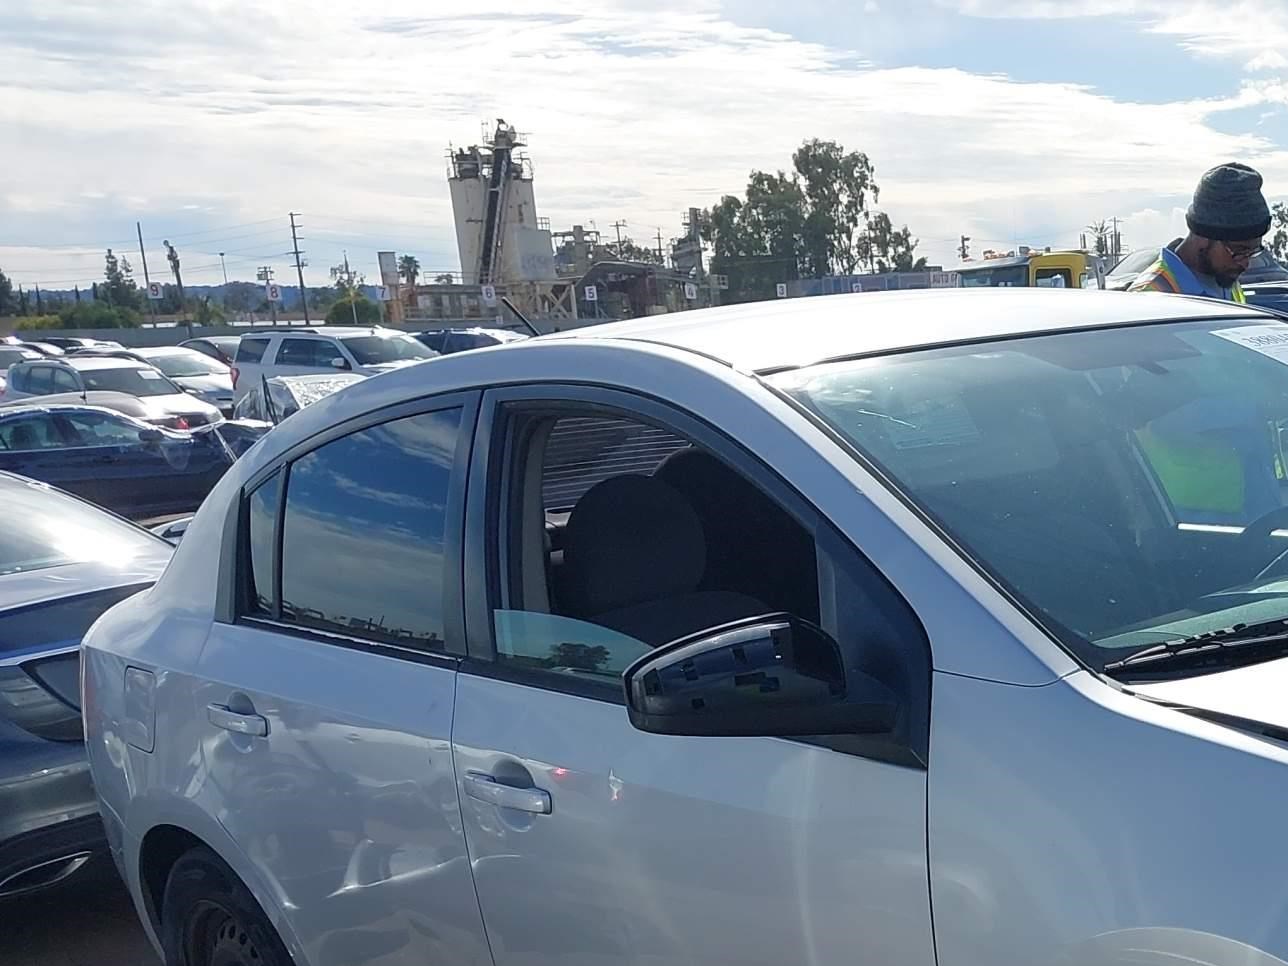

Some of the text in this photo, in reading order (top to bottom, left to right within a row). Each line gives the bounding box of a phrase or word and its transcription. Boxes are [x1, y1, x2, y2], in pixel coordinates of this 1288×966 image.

[149, 284, 159, 297] 9
[270, 286, 279, 299] 8
[485, 287, 493, 299] 6
[588, 287, 595, 299] 5
